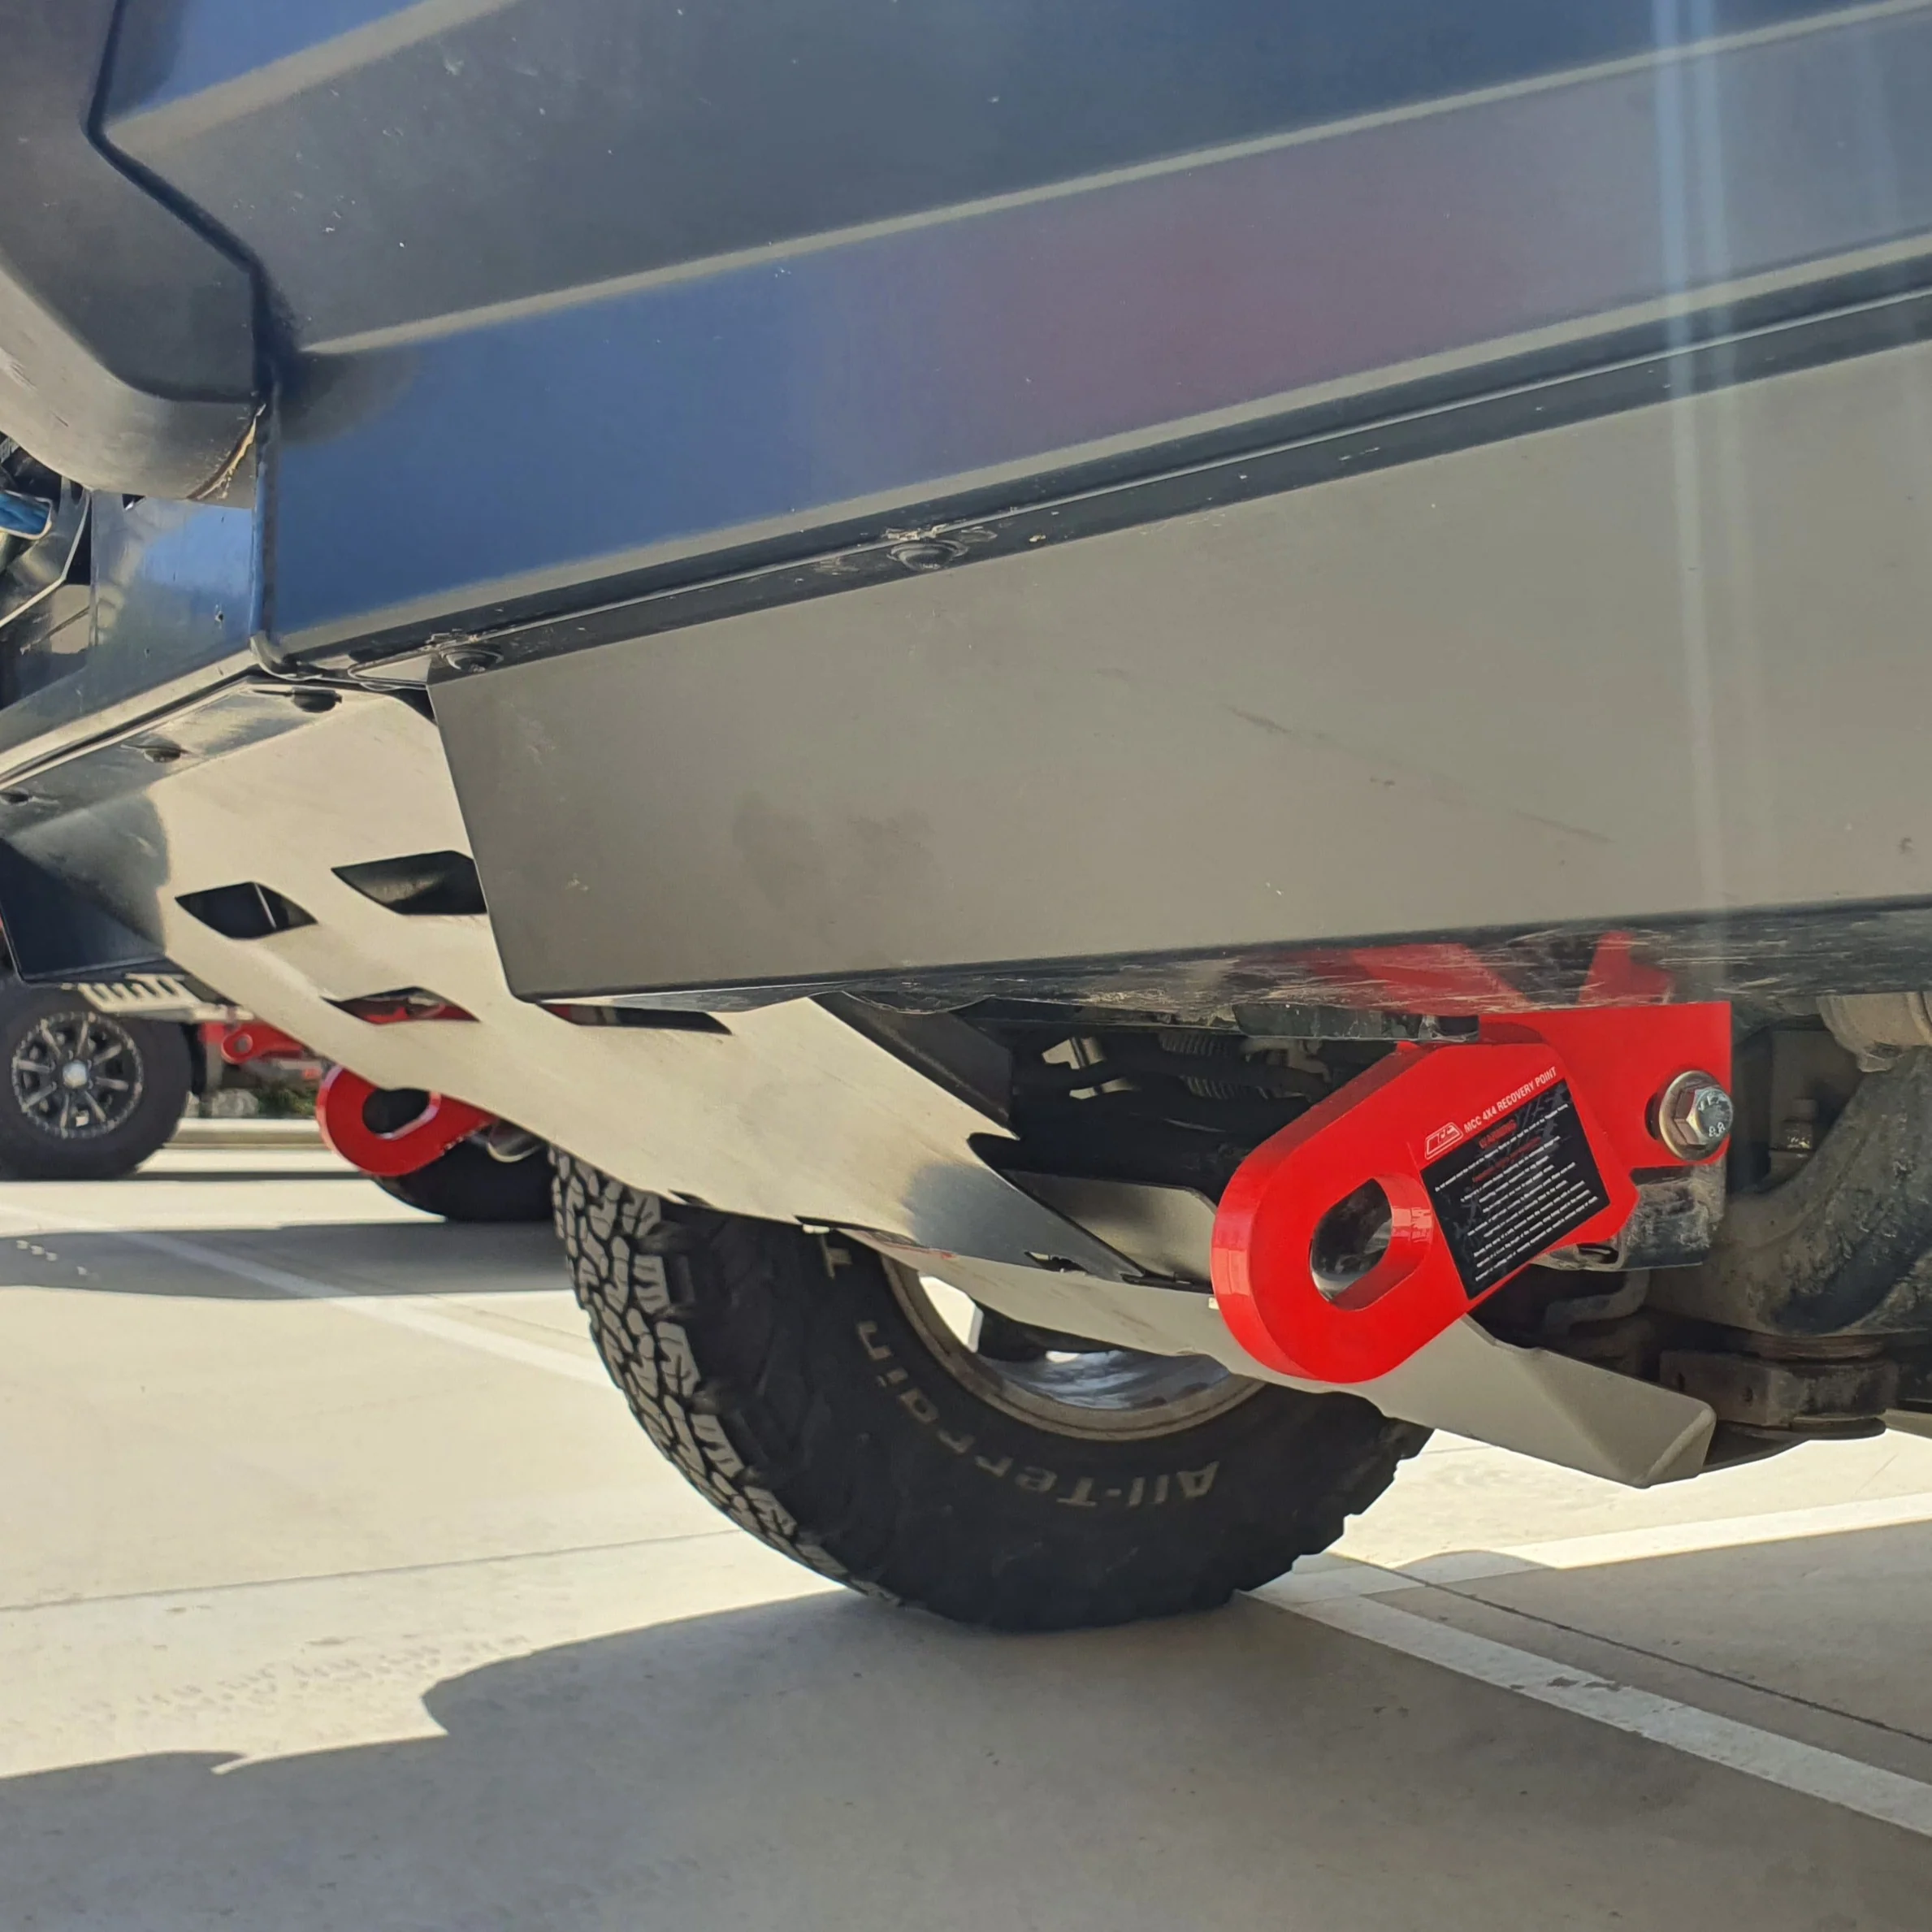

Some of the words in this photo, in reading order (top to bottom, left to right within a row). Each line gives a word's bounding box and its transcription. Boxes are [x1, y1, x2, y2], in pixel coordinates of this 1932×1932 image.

[1463, 1115, 1482, 1133] MCC
[1482, 1105, 1497, 1122] 4X4
[1497, 1081, 1535, 1111] RECOVERY
[1534, 1066, 1557, 1090] POINT
